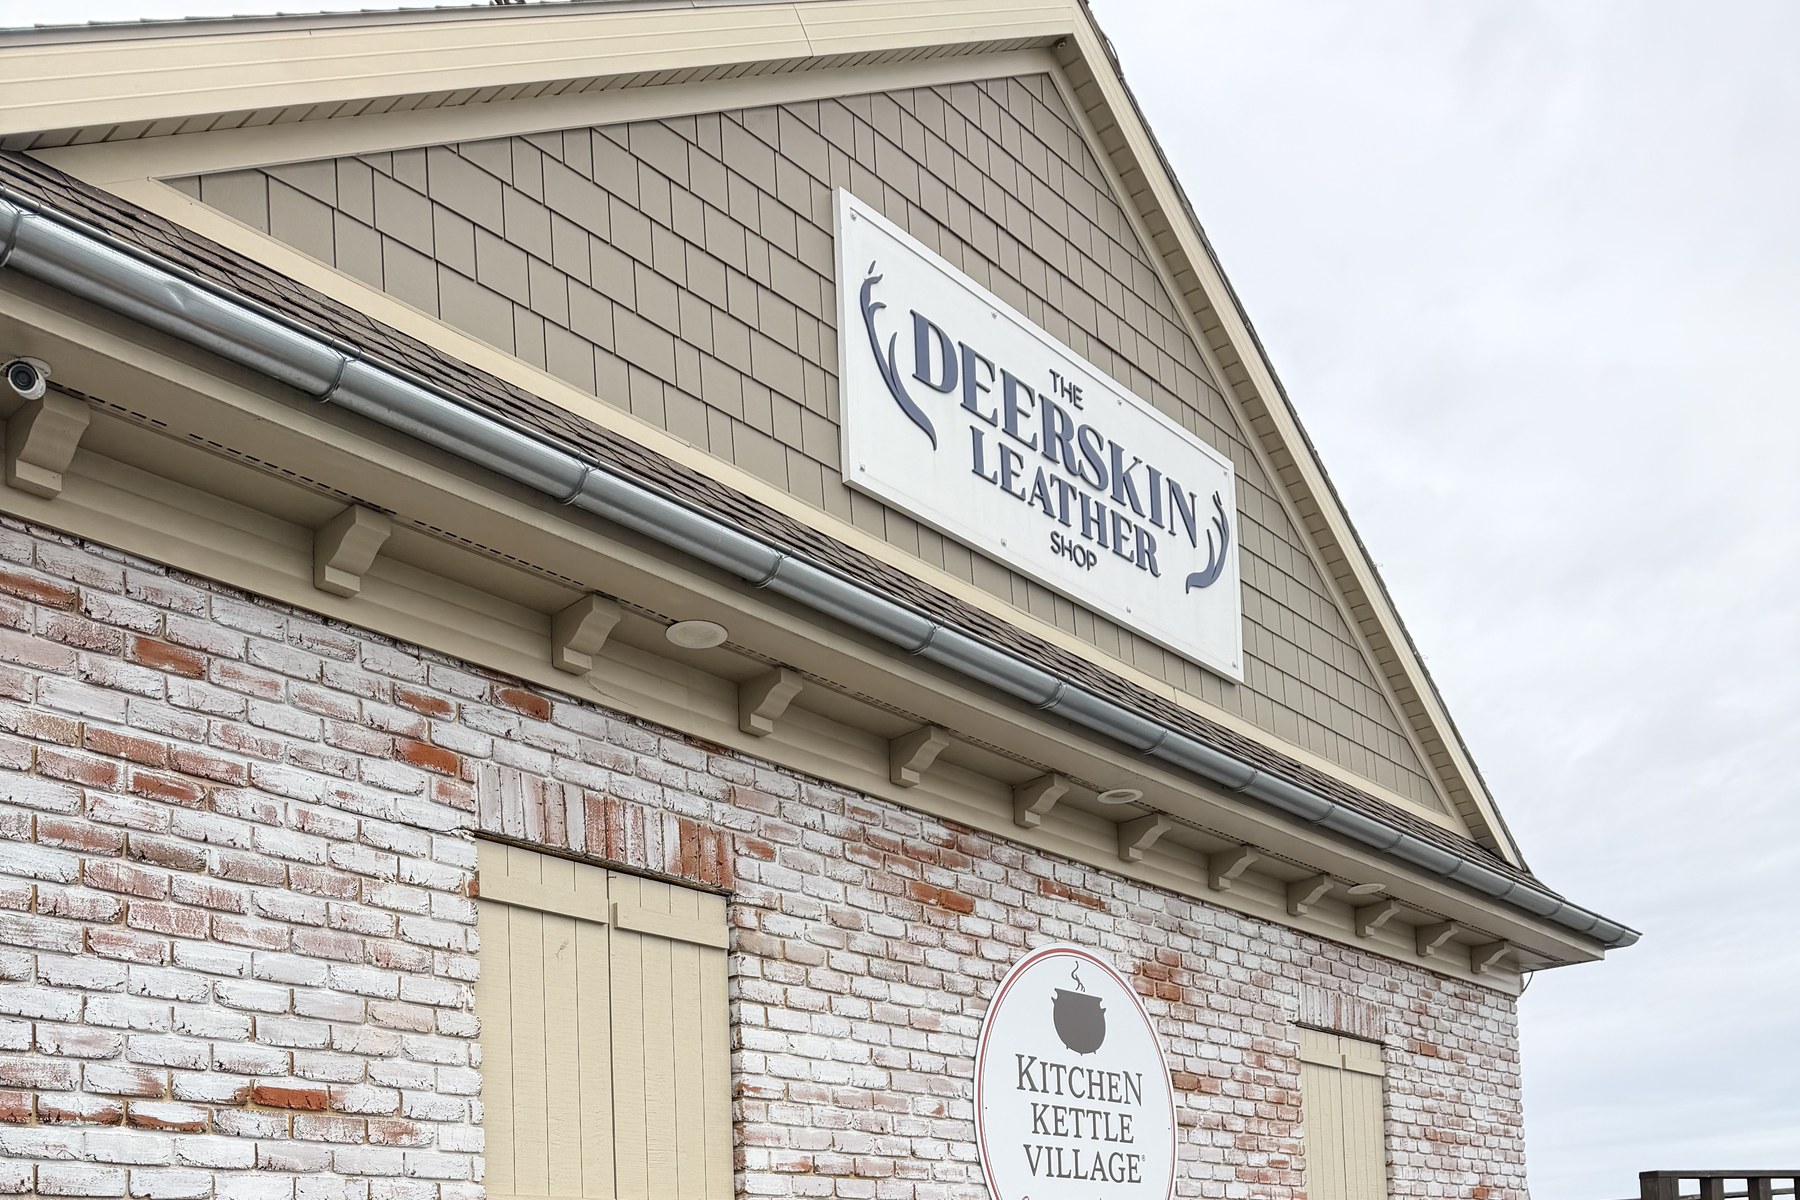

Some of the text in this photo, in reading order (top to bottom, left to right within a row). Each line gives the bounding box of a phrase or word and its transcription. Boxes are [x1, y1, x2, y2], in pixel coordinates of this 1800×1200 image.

[1049, 368, 1084, 411] THE
[909, 309, 1199, 549] DEERSKIN
[969, 424, 1162, 578] LEATHER
[1049, 529, 1098, 572] SHOP
[1015, 1053, 1143, 1107] KITCHEN
[1031, 1102, 1135, 1144] KETTLE
